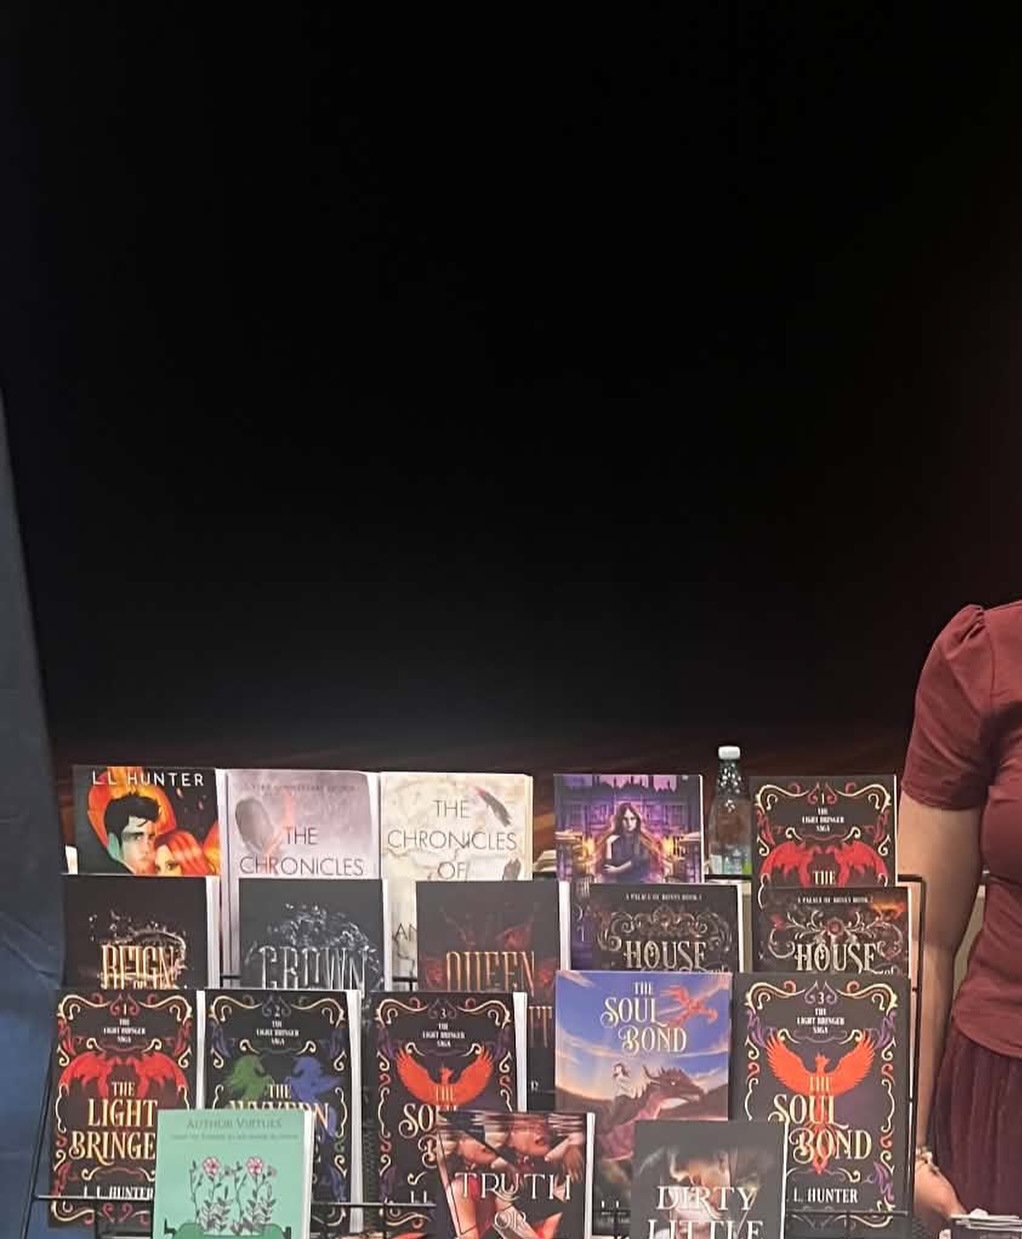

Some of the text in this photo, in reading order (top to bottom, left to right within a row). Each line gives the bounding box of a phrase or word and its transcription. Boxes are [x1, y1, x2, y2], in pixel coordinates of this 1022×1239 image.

[127, 772, 204, 787] HUNTER
[433, 799, 470, 819] THE
[282, 826, 318, 845] THE
[387, 827, 517, 851] CHRONICLES
[239, 855, 364, 877] CHRONICLES
[437, 860, 466, 880] OF
[813, 870, 836, 886] THE
[101, 944, 177, 990] REIGN
[623, 940, 706, 973] HOUSE
[794, 943, 877, 975] HOUSE
[259, 946, 368, 994] CROWN
[631, 981, 653, 995] THE
[600, 996, 670, 1028] SOUL
[618, 1026, 688, 1055] BOND
[112, 1082, 135, 1097] THE
[267, 1084, 291, 1099] THE
[809, 1076, 832, 1092] THE
[88, 1099, 158, 1127] LIGHT
[768, 1094, 850, 1130] SOUL
[69, 1131, 156, 1166] BRINGE
[788, 1129, 873, 1164] BOND
[452, 1172, 571, 1201] TRUTH
[807, 1188, 858, 1204] HUNTER
[657, 1186, 757, 1220] DIRTY
[494, 1211, 527, 1231] OR
